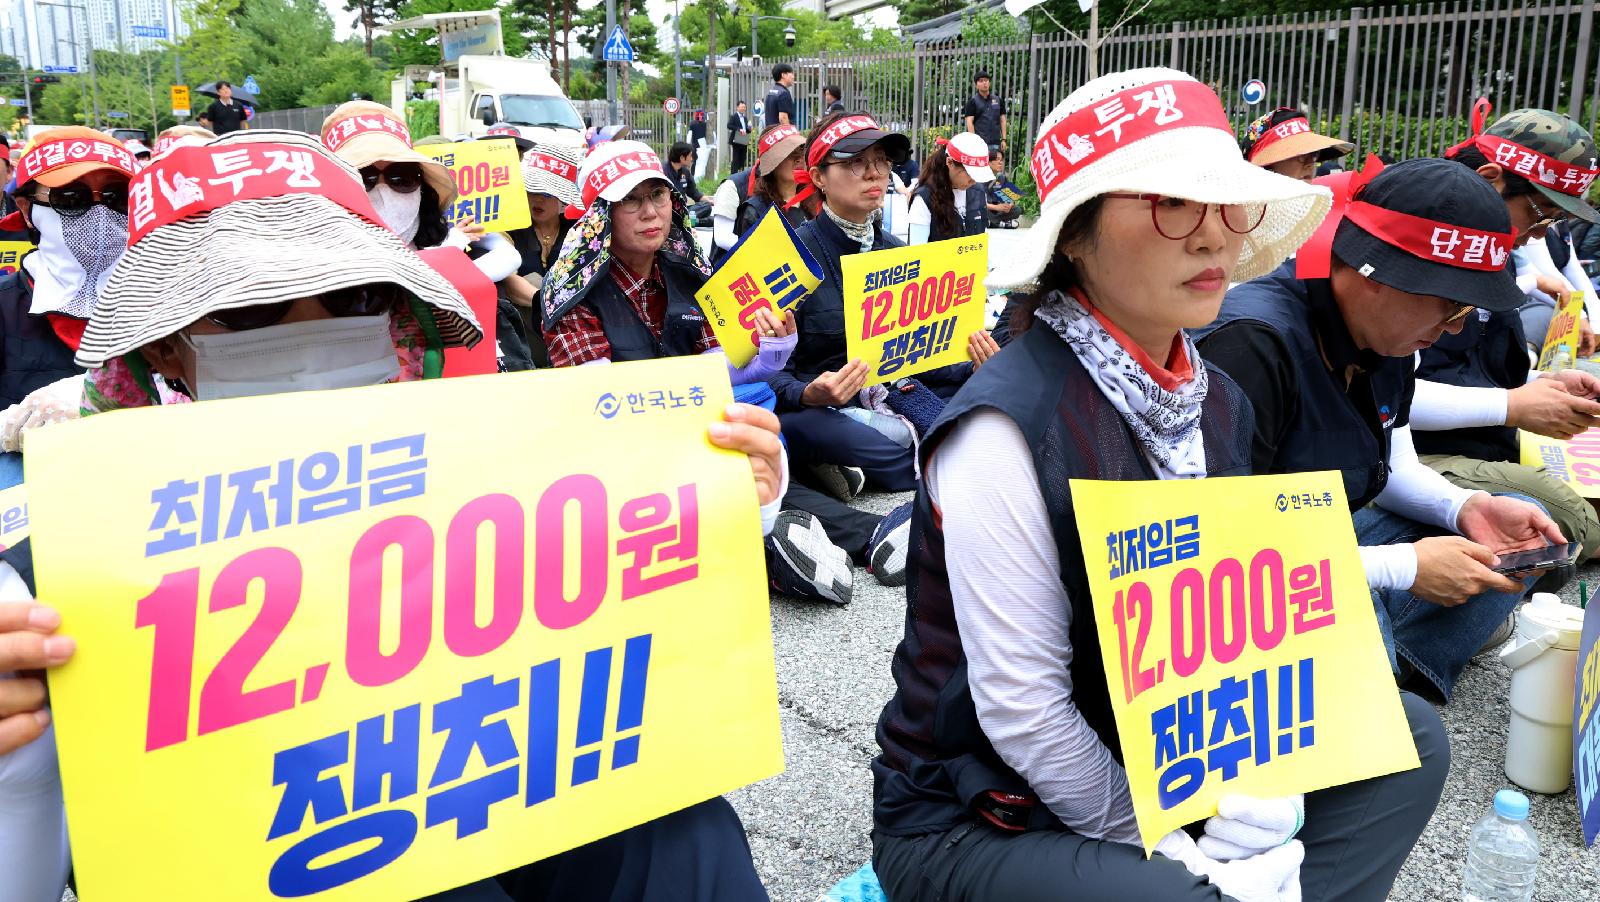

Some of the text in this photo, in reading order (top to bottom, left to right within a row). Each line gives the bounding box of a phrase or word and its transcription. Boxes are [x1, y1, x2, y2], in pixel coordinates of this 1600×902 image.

[327, 117, 358, 150] 단결
[1095, 84, 1183, 143] 투쟁
[25, 142, 65, 177] 단결
[93, 142, 133, 171] 투쟁
[590, 160, 621, 191] 단결
[1496, 143, 1539, 175] 단결
[128, 149, 321, 231] 결 투쟁
[1431, 226, 1489, 263] 단결
[861, 270, 976, 341] 12,000원
[863, 260, 921, 293] 최저임금
[877, 315, 958, 377] 쟁취!!
[625, 385, 706, 416] 한국노총
[145, 433, 428, 557] 최저임금
[1291, 492, 1333, 511] 한국노총
[1106, 514, 1201, 581] 최저임금
[135, 473, 699, 753] 12,000원
[1112, 548, 1336, 705] 12,000원
[1151, 657, 1315, 811] 쟁취!!
[266, 633, 653, 898] 쟁취!!
